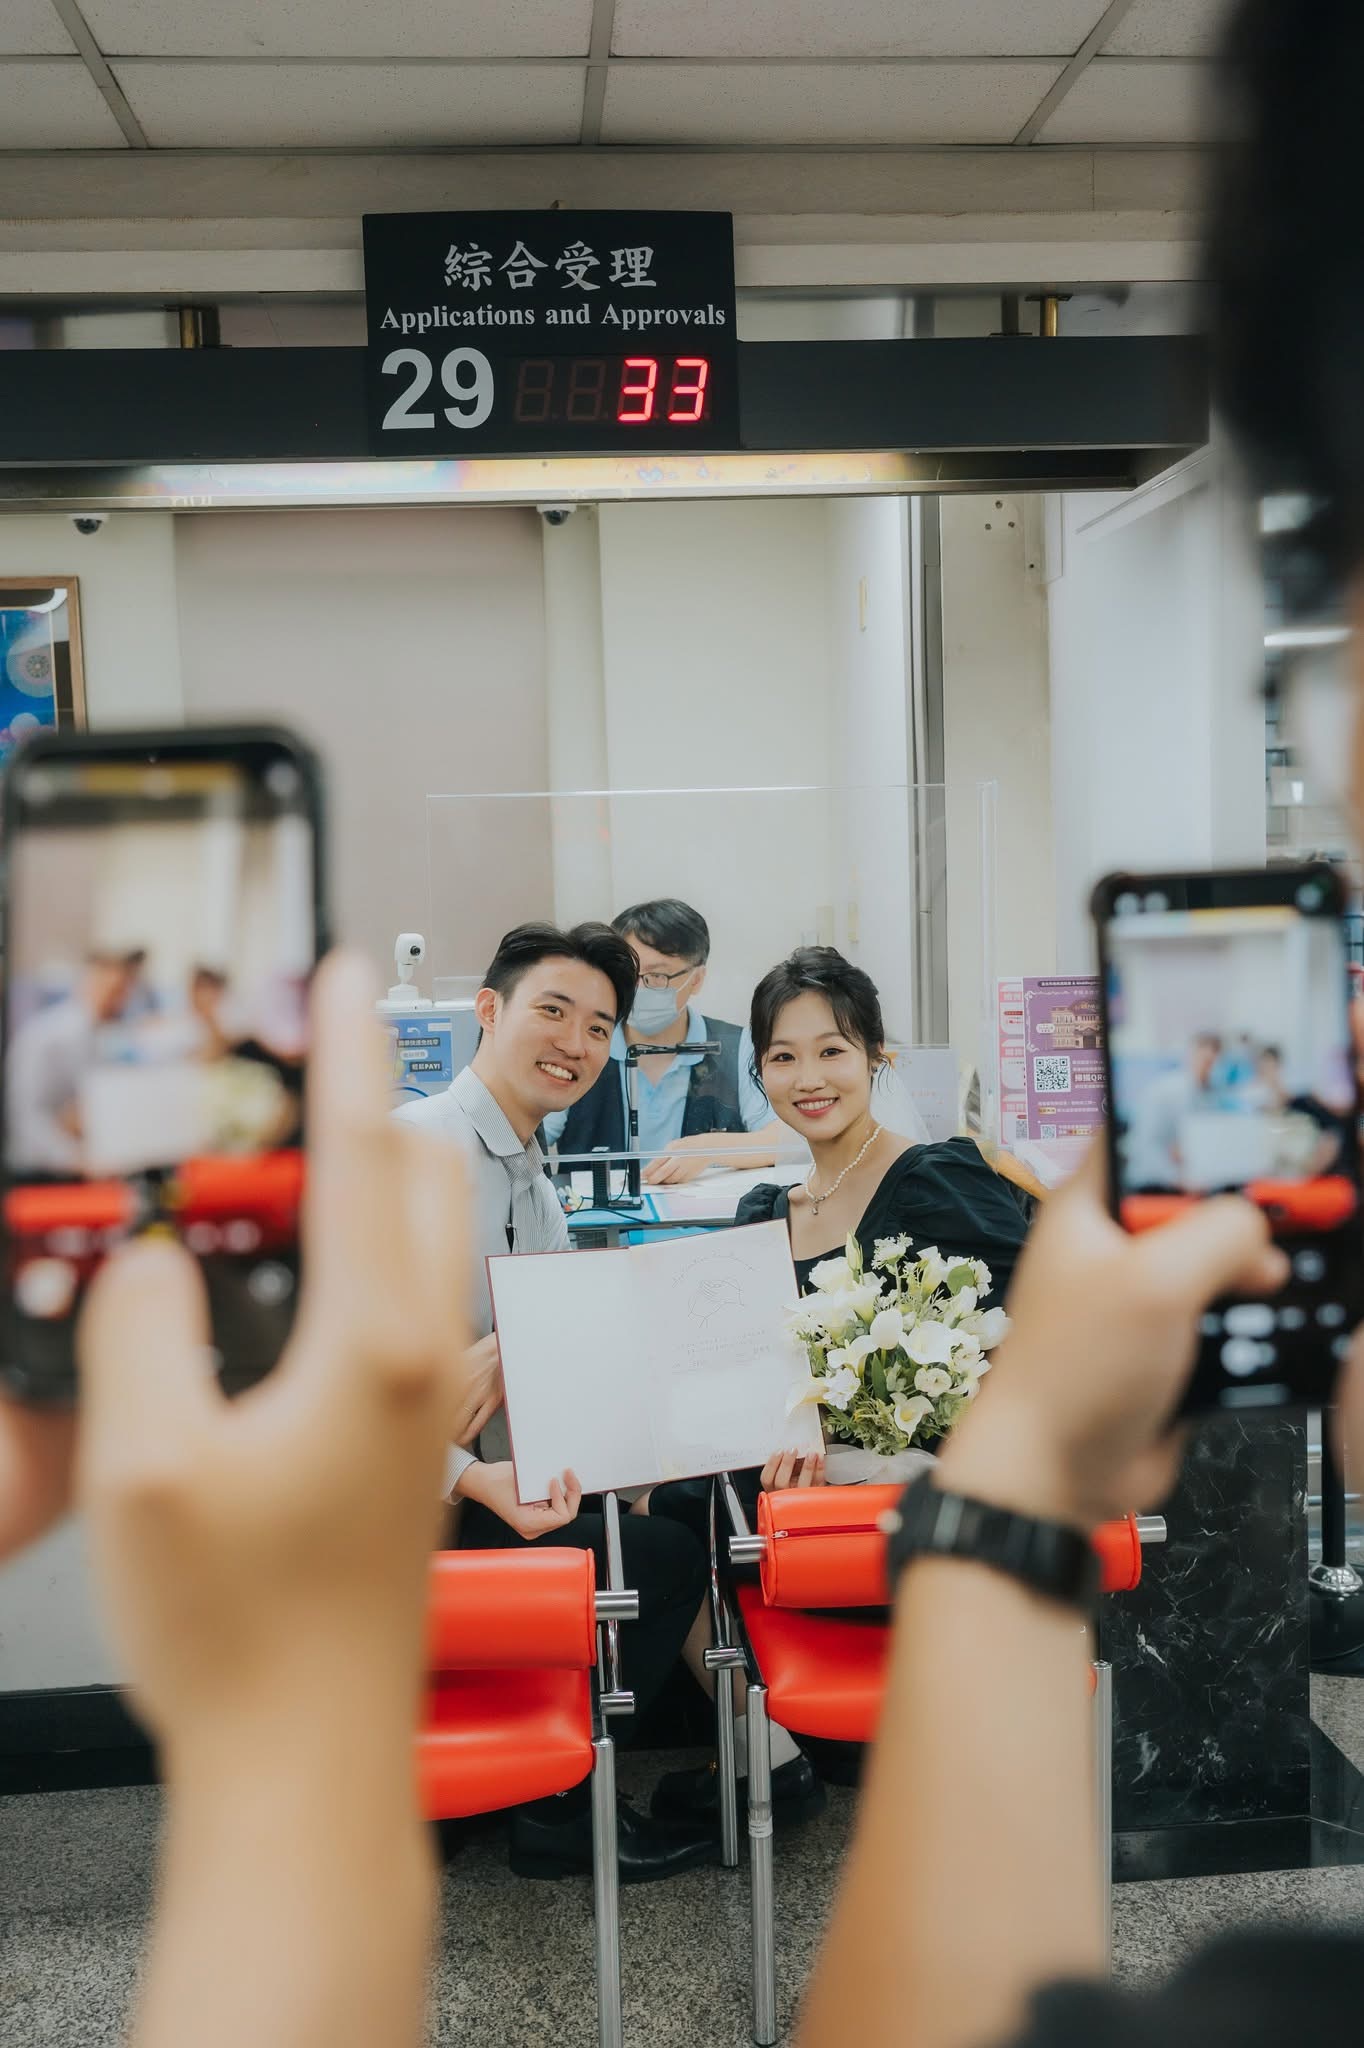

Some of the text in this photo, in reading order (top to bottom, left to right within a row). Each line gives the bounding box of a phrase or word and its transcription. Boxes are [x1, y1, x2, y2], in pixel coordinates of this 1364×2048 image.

[443, 240, 657, 292] 綜合受理
[380, 303, 726, 335] Applications and Approvals
[381, 346, 495, 430] 29
[617, 357, 709, 422] 33
